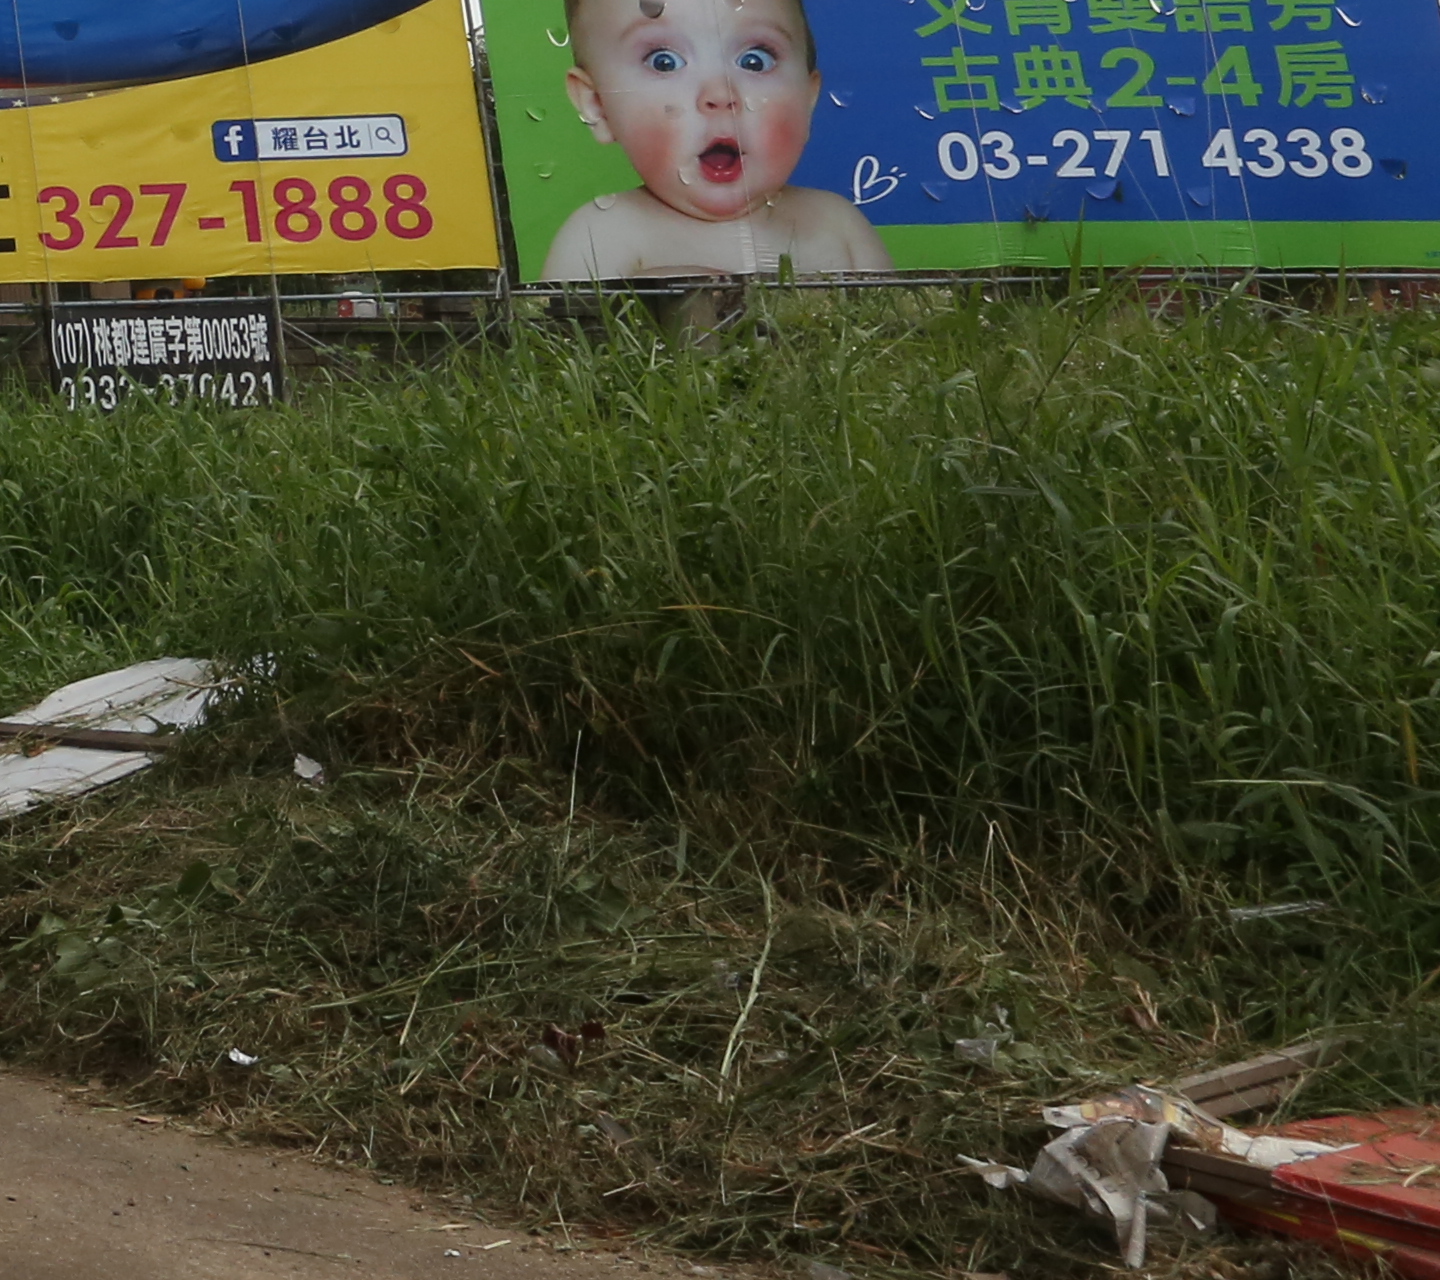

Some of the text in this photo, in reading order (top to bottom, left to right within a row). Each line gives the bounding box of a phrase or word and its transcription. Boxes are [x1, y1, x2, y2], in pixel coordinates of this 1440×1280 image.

[920, 41, 1356, 114] 古典2-4房
[271, 124, 361, 152] 耀台北
[938, 127, 1373, 181] 03-271 4338
[37, 173, 435, 252] 327-1888
[51, 318, 92, 369] (107)
